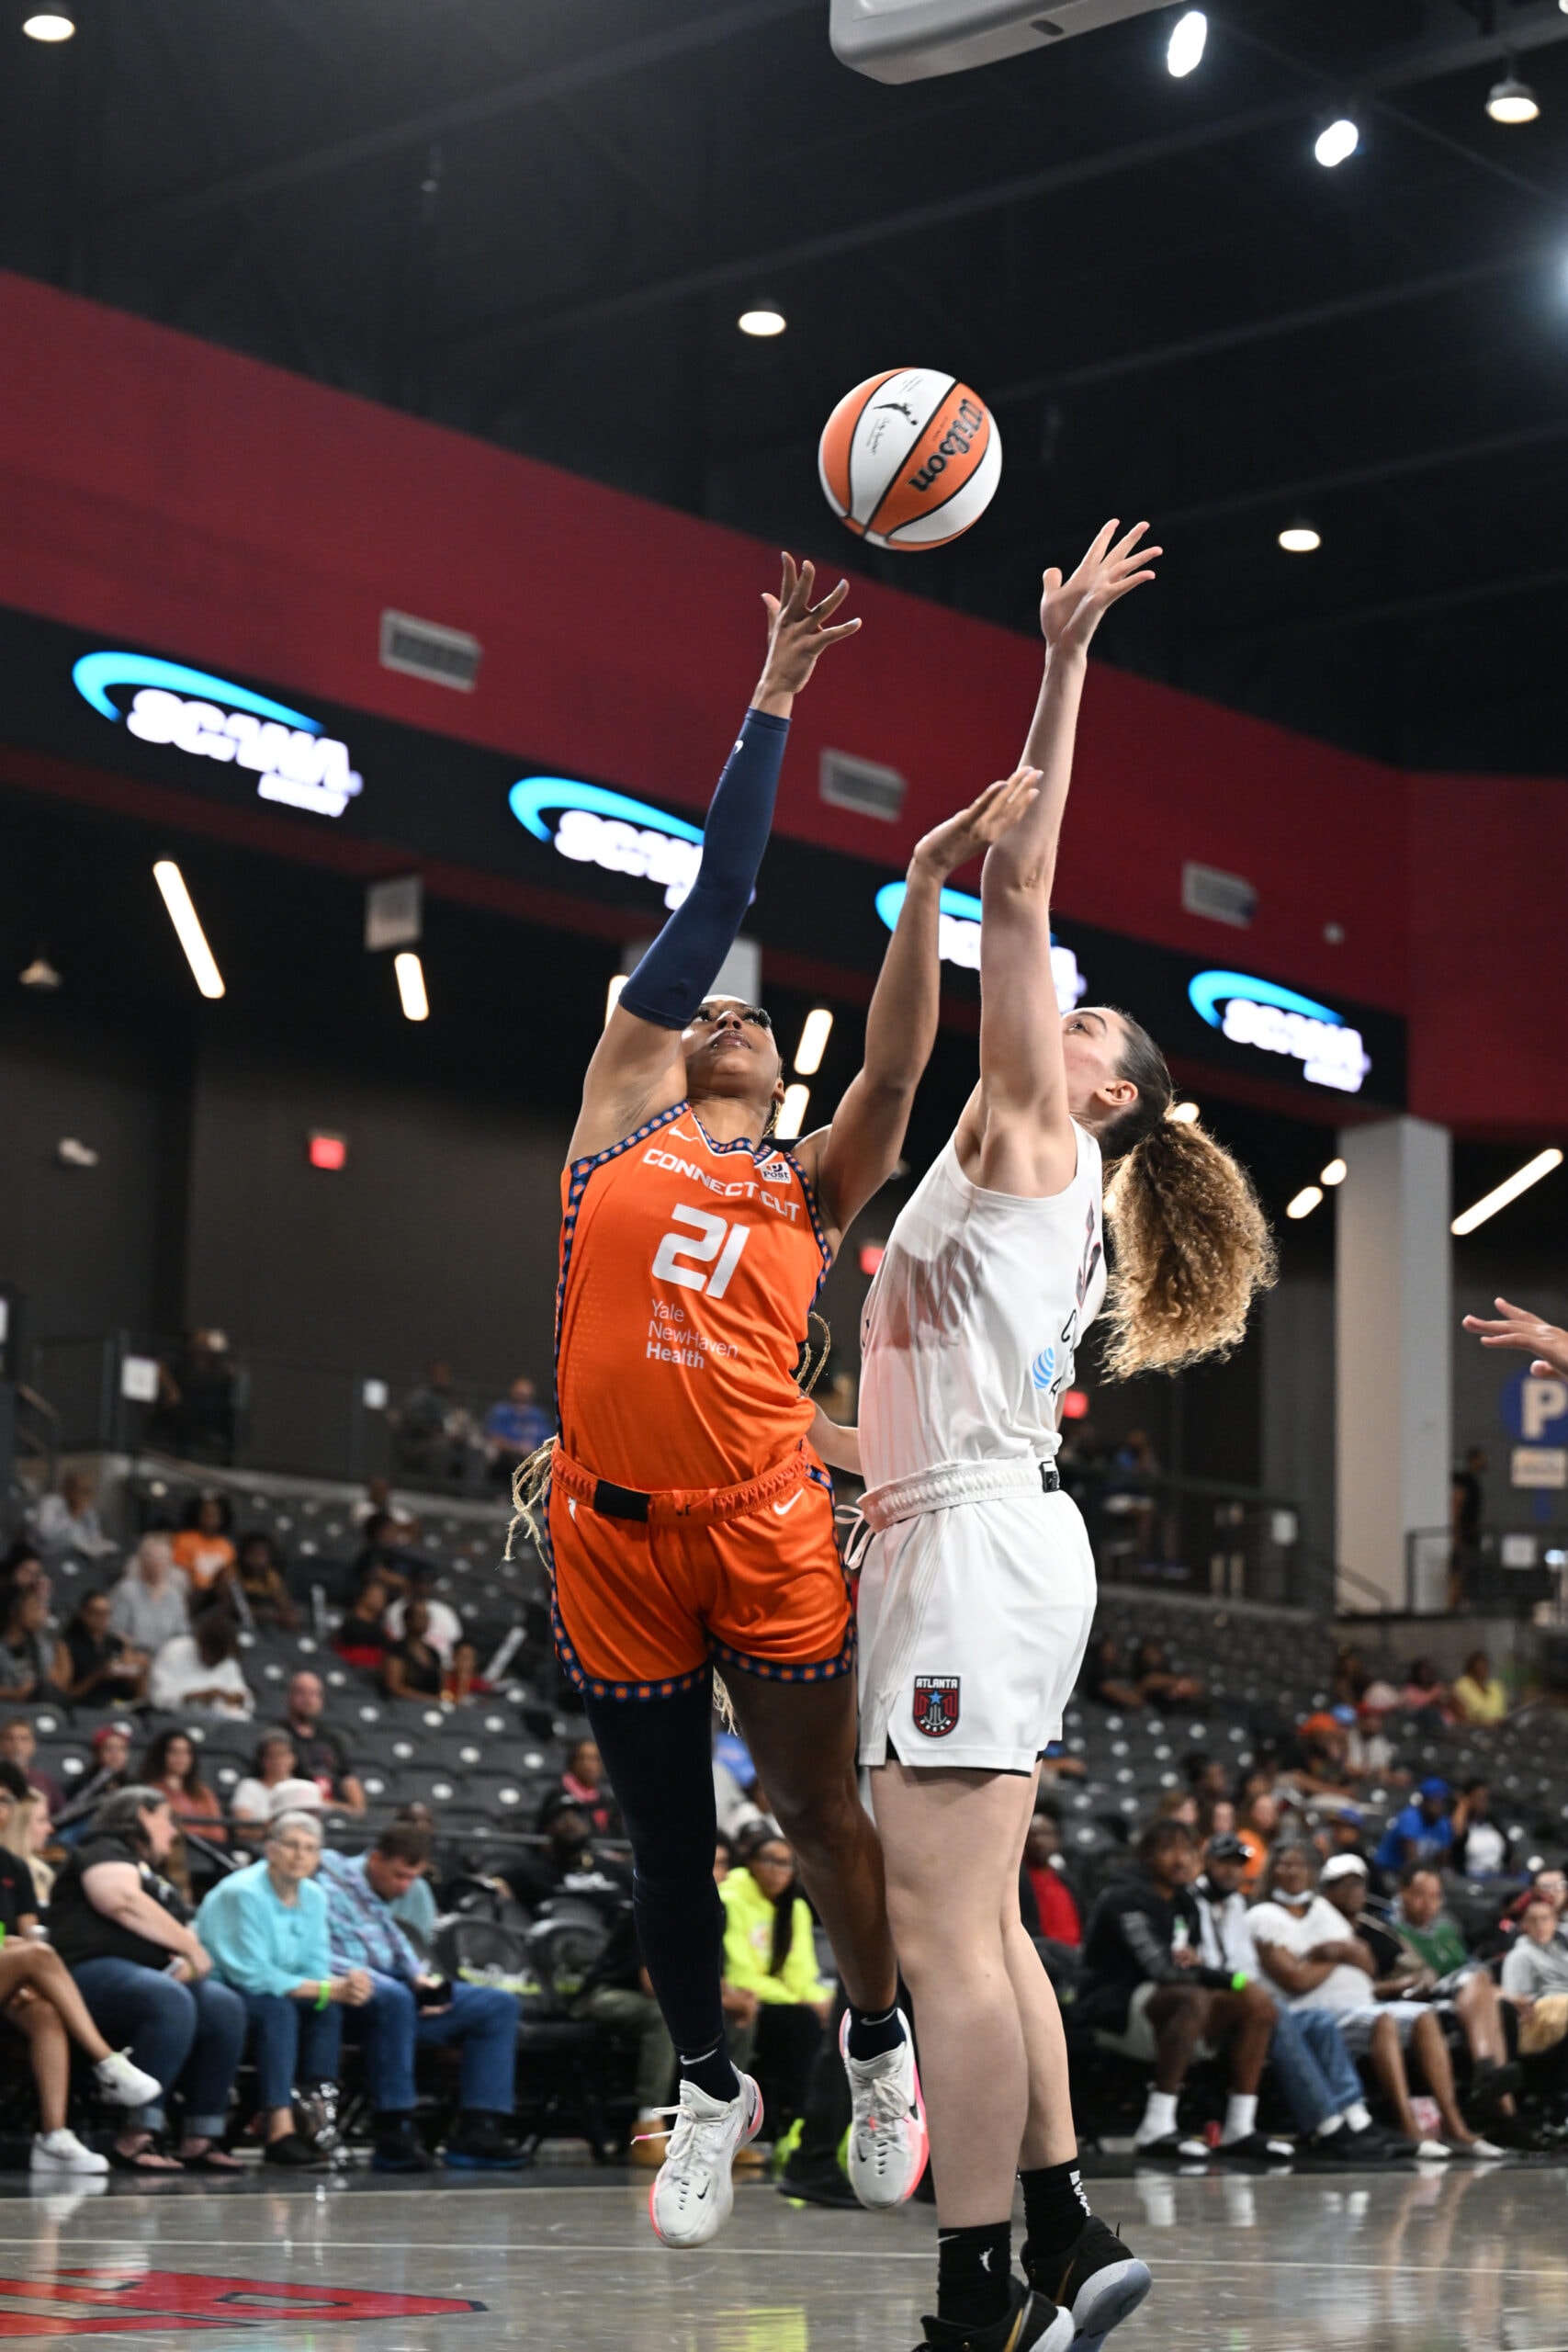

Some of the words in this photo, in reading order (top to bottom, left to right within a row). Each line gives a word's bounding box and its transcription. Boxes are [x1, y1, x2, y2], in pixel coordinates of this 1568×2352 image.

[908, 398, 984, 492] Wilson
[642, 1148, 800, 1222] CONNECTCUT
[763, 1170, 789, 1179] Post
[651, 1203, 750, 1299] 21
[651, 1299, 684, 1322] Yale
[646, 1341, 705, 1369] Health
[649, 1320, 739, 1358] NewHaven
[1522, 1379, 1568, 1440] P
[916, 1678, 958, 1689] ATLANTA
